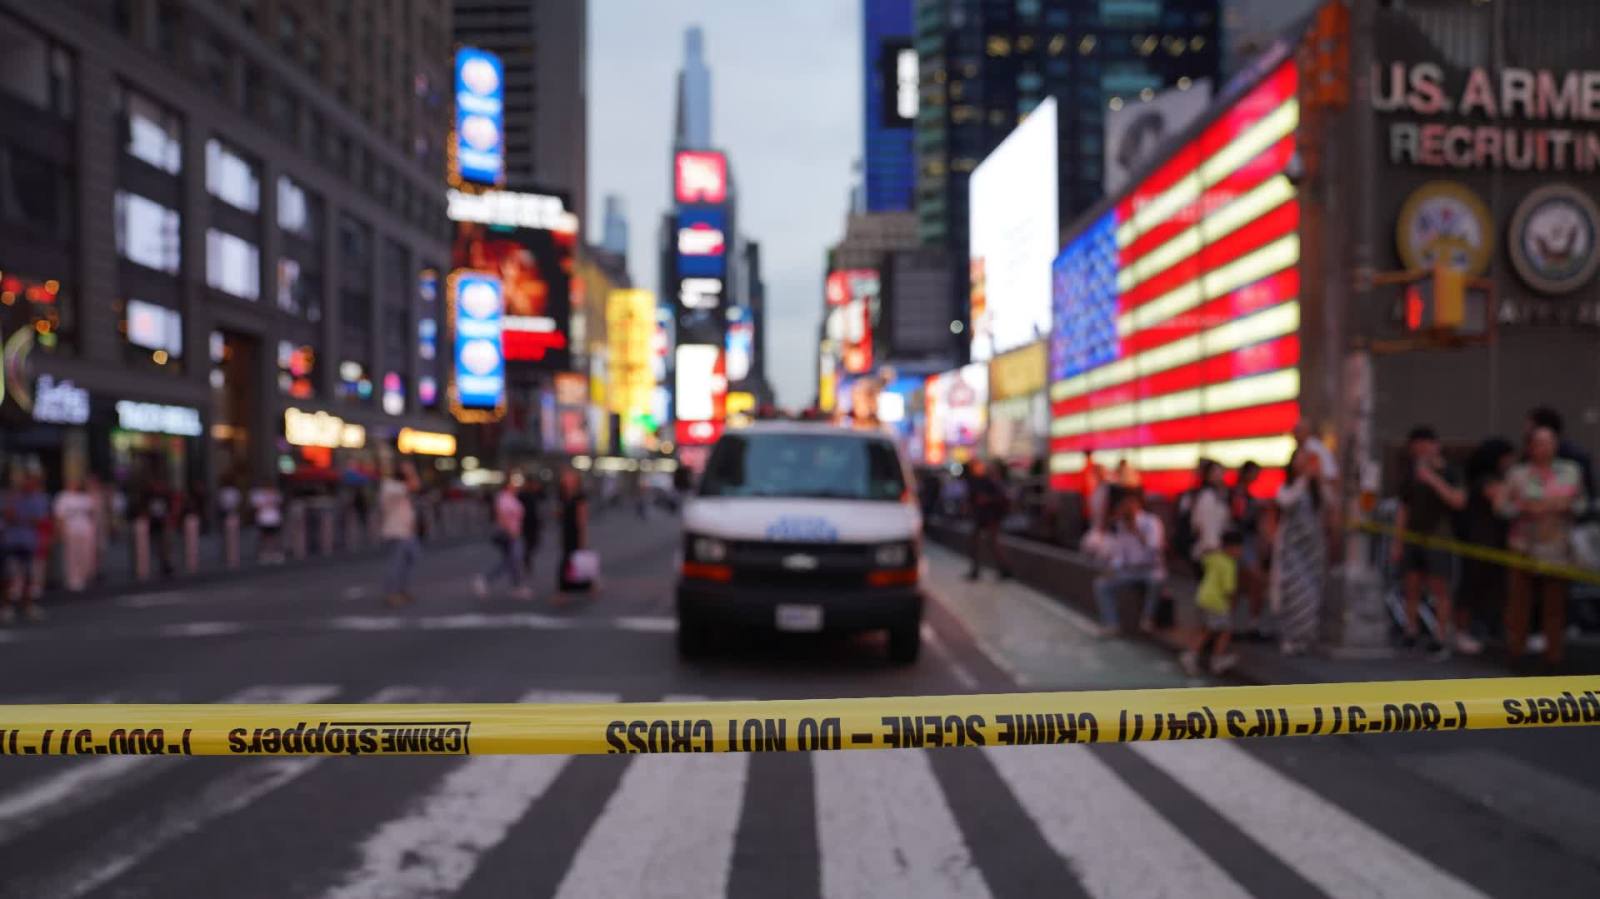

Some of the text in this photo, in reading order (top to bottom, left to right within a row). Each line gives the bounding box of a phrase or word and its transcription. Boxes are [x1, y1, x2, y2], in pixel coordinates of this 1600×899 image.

[607, 720, 713, 754] CROSS
[724, 718, 787, 752] NOT
[799, 717, 841, 752] DO
[882, 714, 986, 748] SCENE
[996, 712, 1098, 745] CRIME
